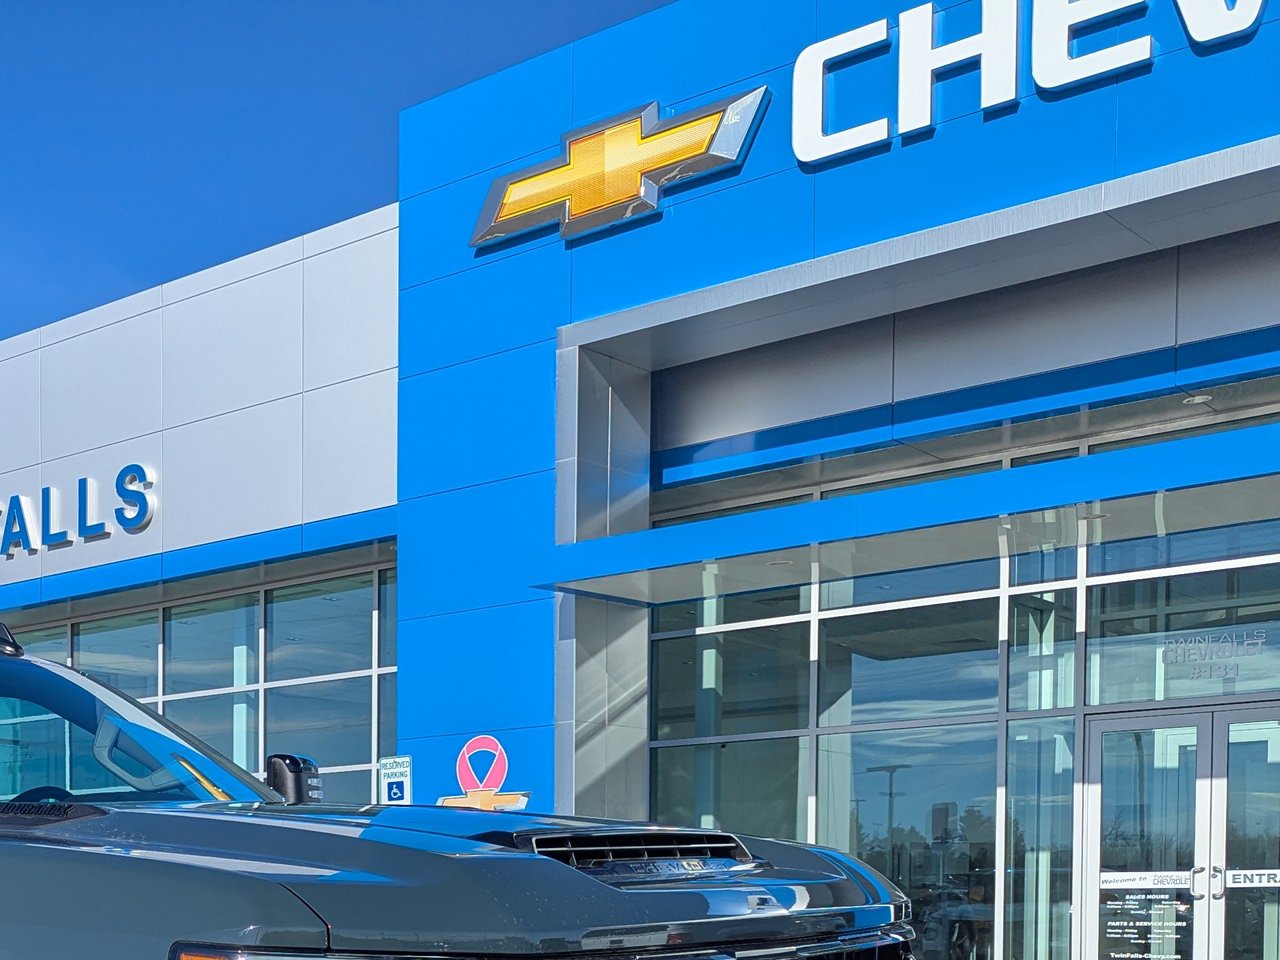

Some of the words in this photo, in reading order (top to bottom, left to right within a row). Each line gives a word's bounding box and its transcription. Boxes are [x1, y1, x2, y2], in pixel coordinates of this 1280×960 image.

[1162, 640, 1266, 664] CHEVROLET
[381, 761, 410, 770] RESERVED
[383, 771, 408, 779] PARKING
[1101, 877, 1137, 885] Welcome
[1152, 878, 1190, 886] CHEVROLE
[1232, 873, 1280, 884] ENTR
